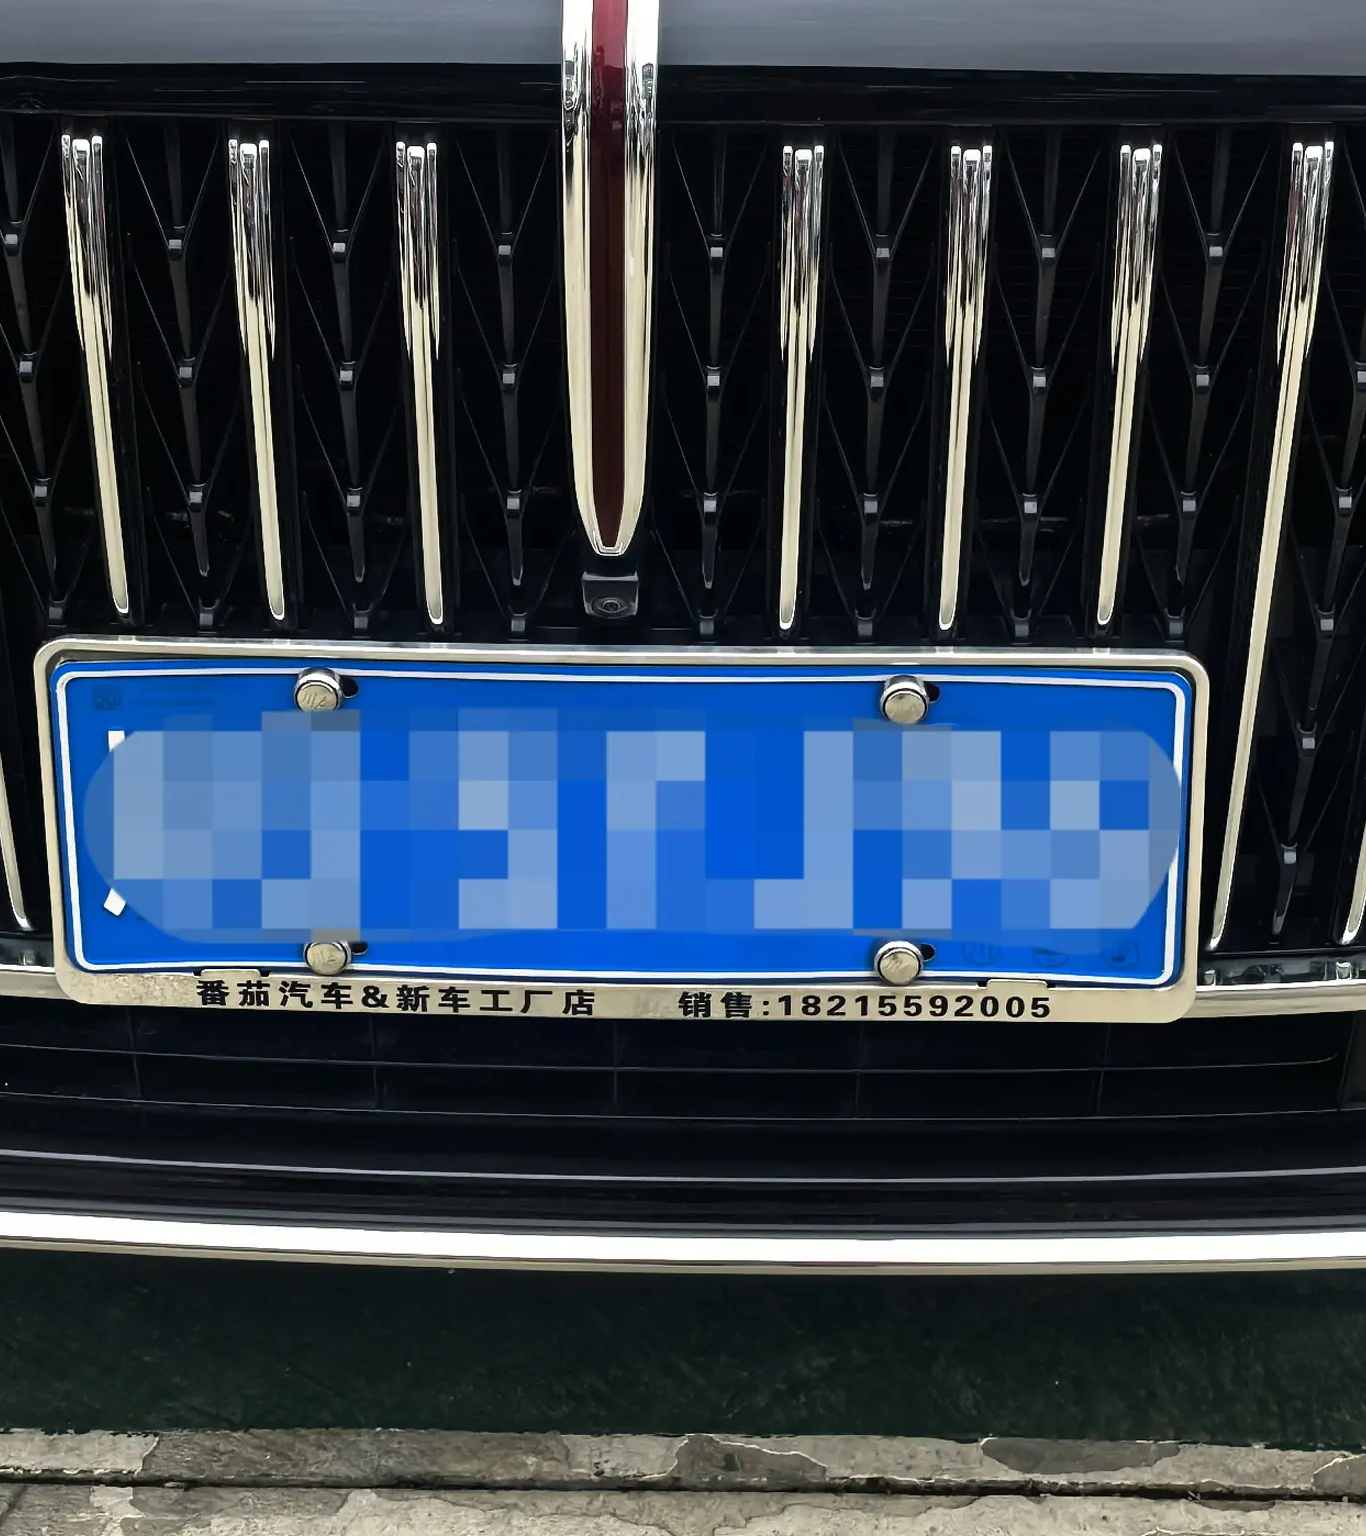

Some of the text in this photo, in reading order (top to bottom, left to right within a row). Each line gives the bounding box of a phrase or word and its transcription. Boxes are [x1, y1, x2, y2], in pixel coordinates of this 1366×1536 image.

[196, 979, 1051, 1019] 番茄汽车&新车工厂店 销售:18215592005
